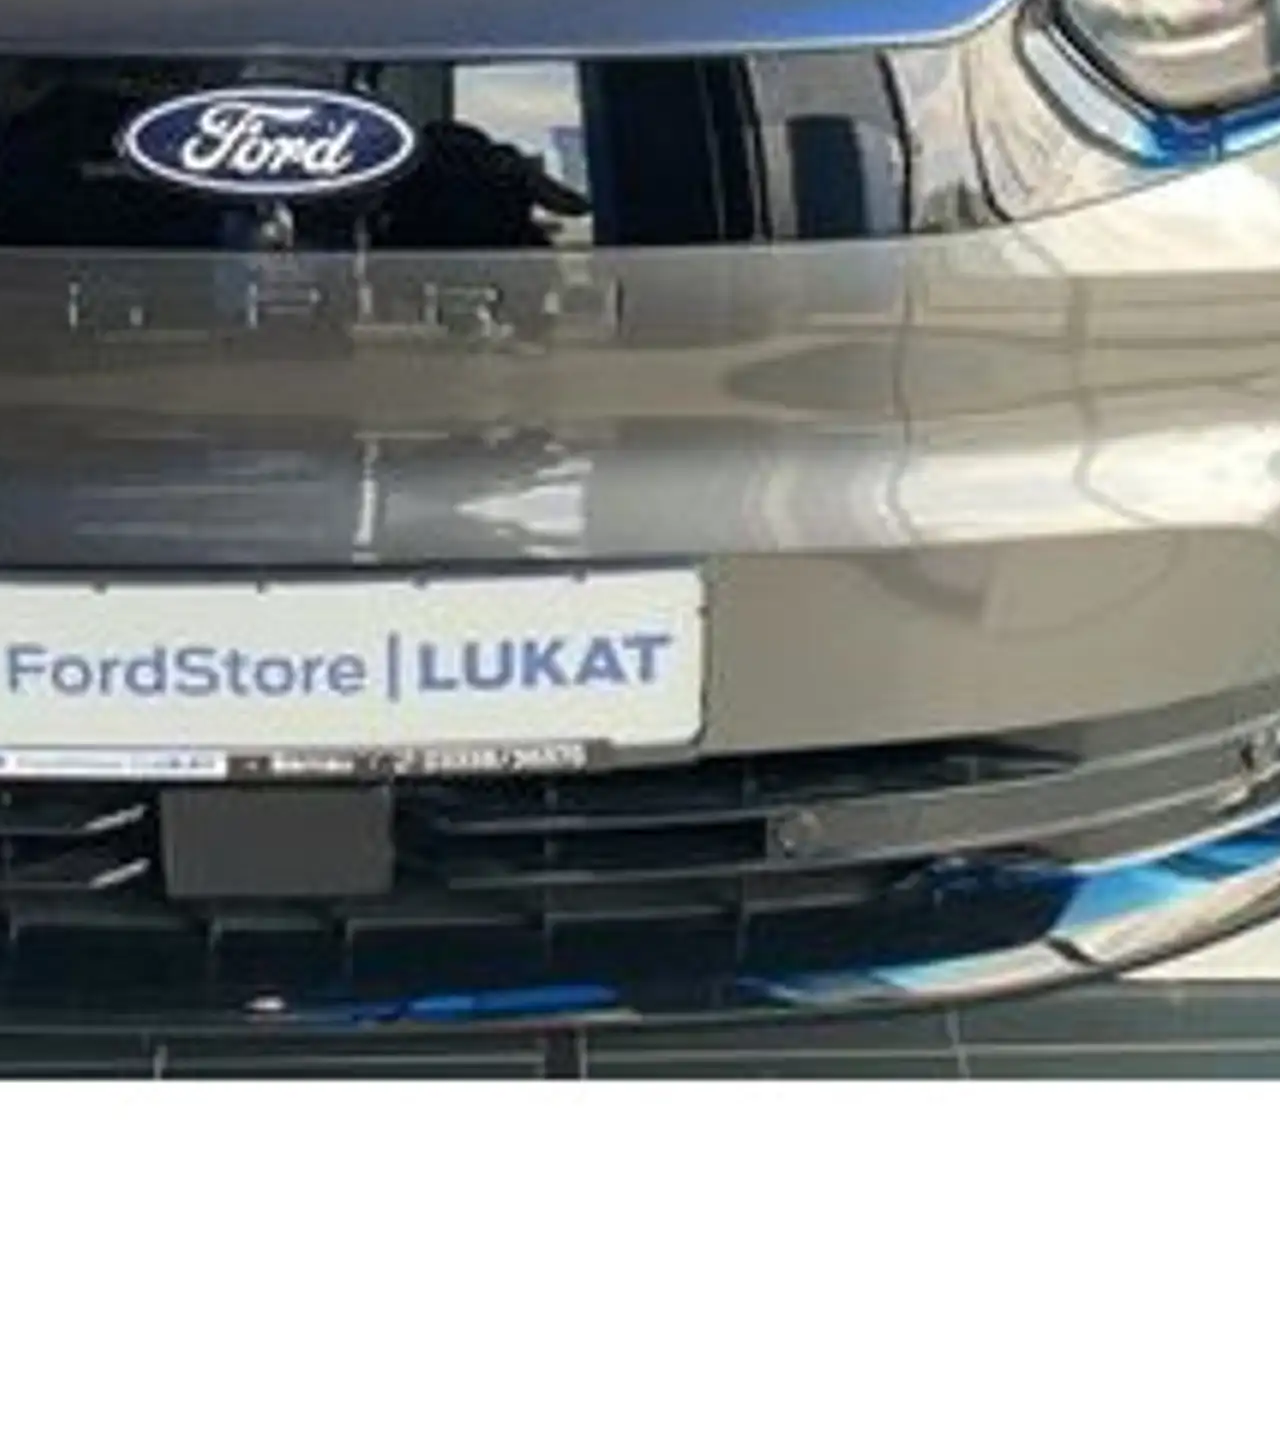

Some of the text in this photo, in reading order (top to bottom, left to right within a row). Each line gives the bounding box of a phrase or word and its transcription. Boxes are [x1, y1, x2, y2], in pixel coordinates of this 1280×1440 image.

[182, 101, 357, 174] Ford
[6, 642, 367, 697] FordStore
[419, 635, 671, 691] LUKAT
